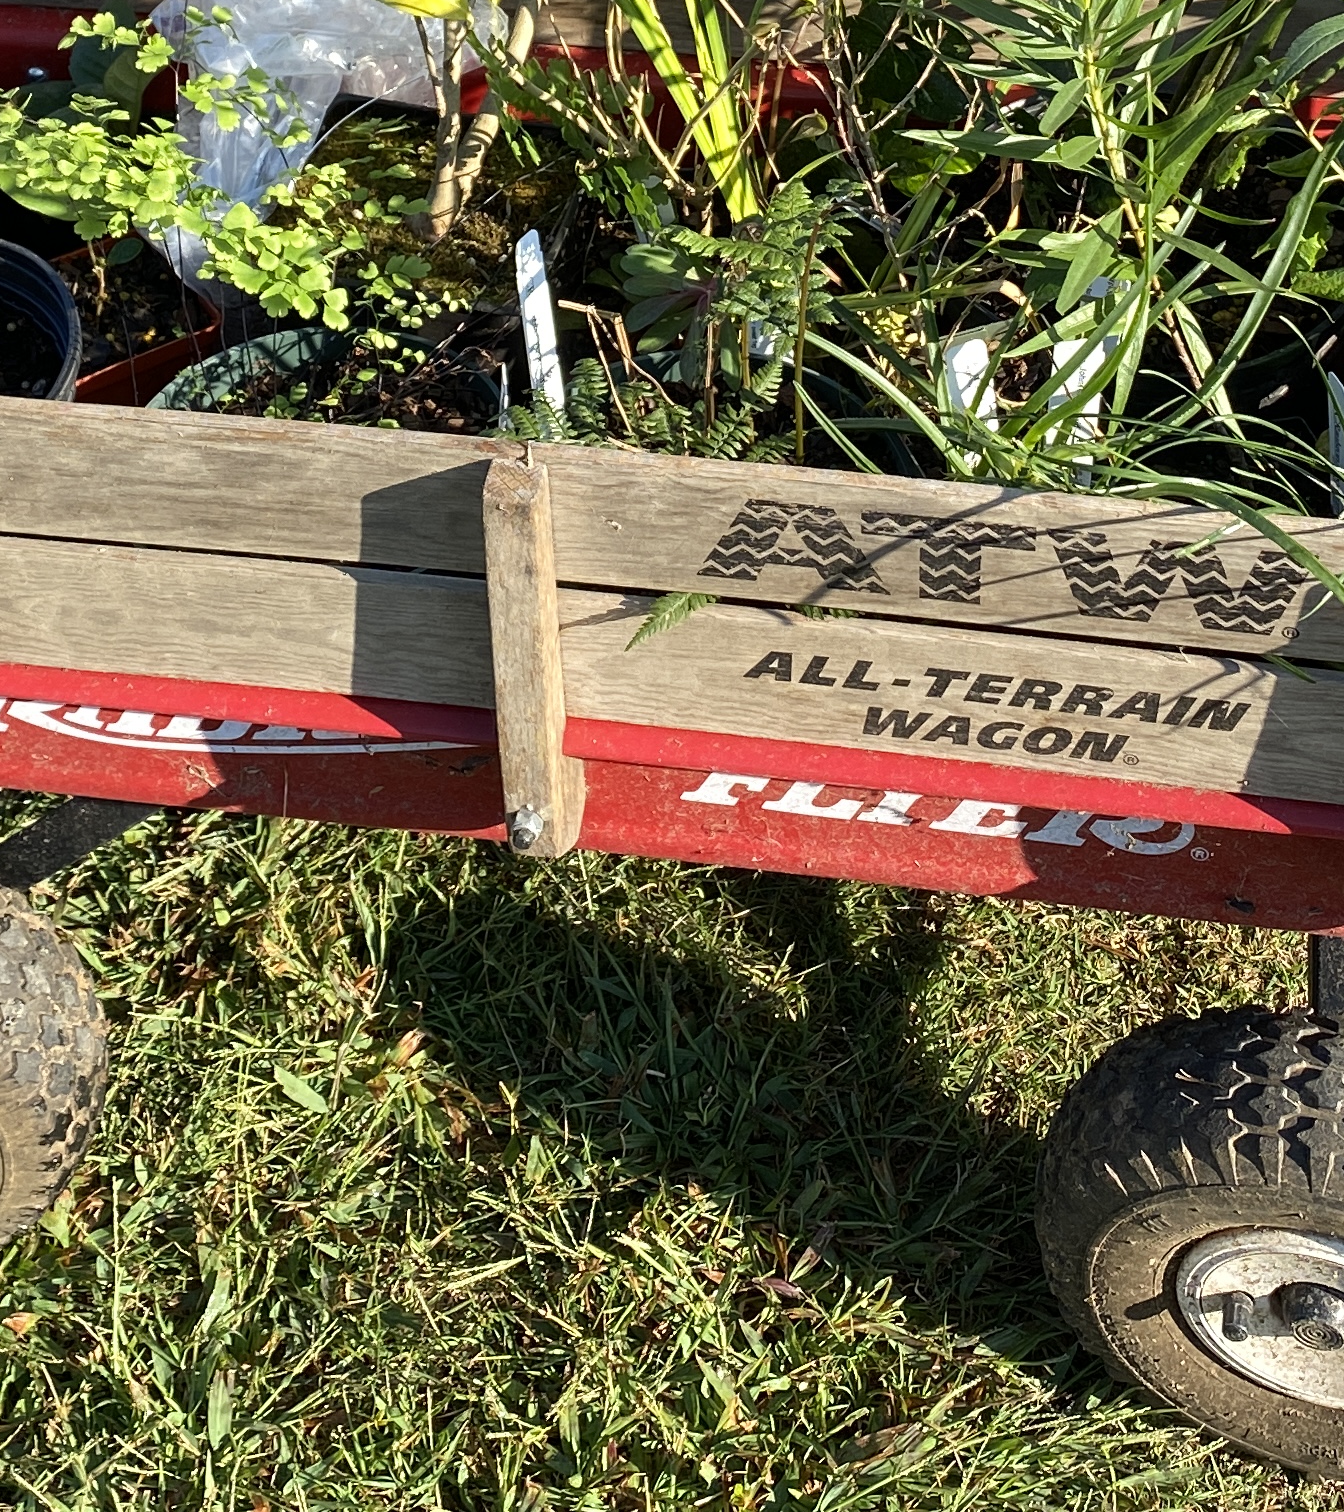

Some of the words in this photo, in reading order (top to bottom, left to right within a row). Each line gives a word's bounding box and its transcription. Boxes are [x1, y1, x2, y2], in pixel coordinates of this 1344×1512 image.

[697, 498, 1315, 636] ATW
[744, 650, 1251, 732] ALL-TERRAIN
[862, 706, 1130, 763] WAGON
